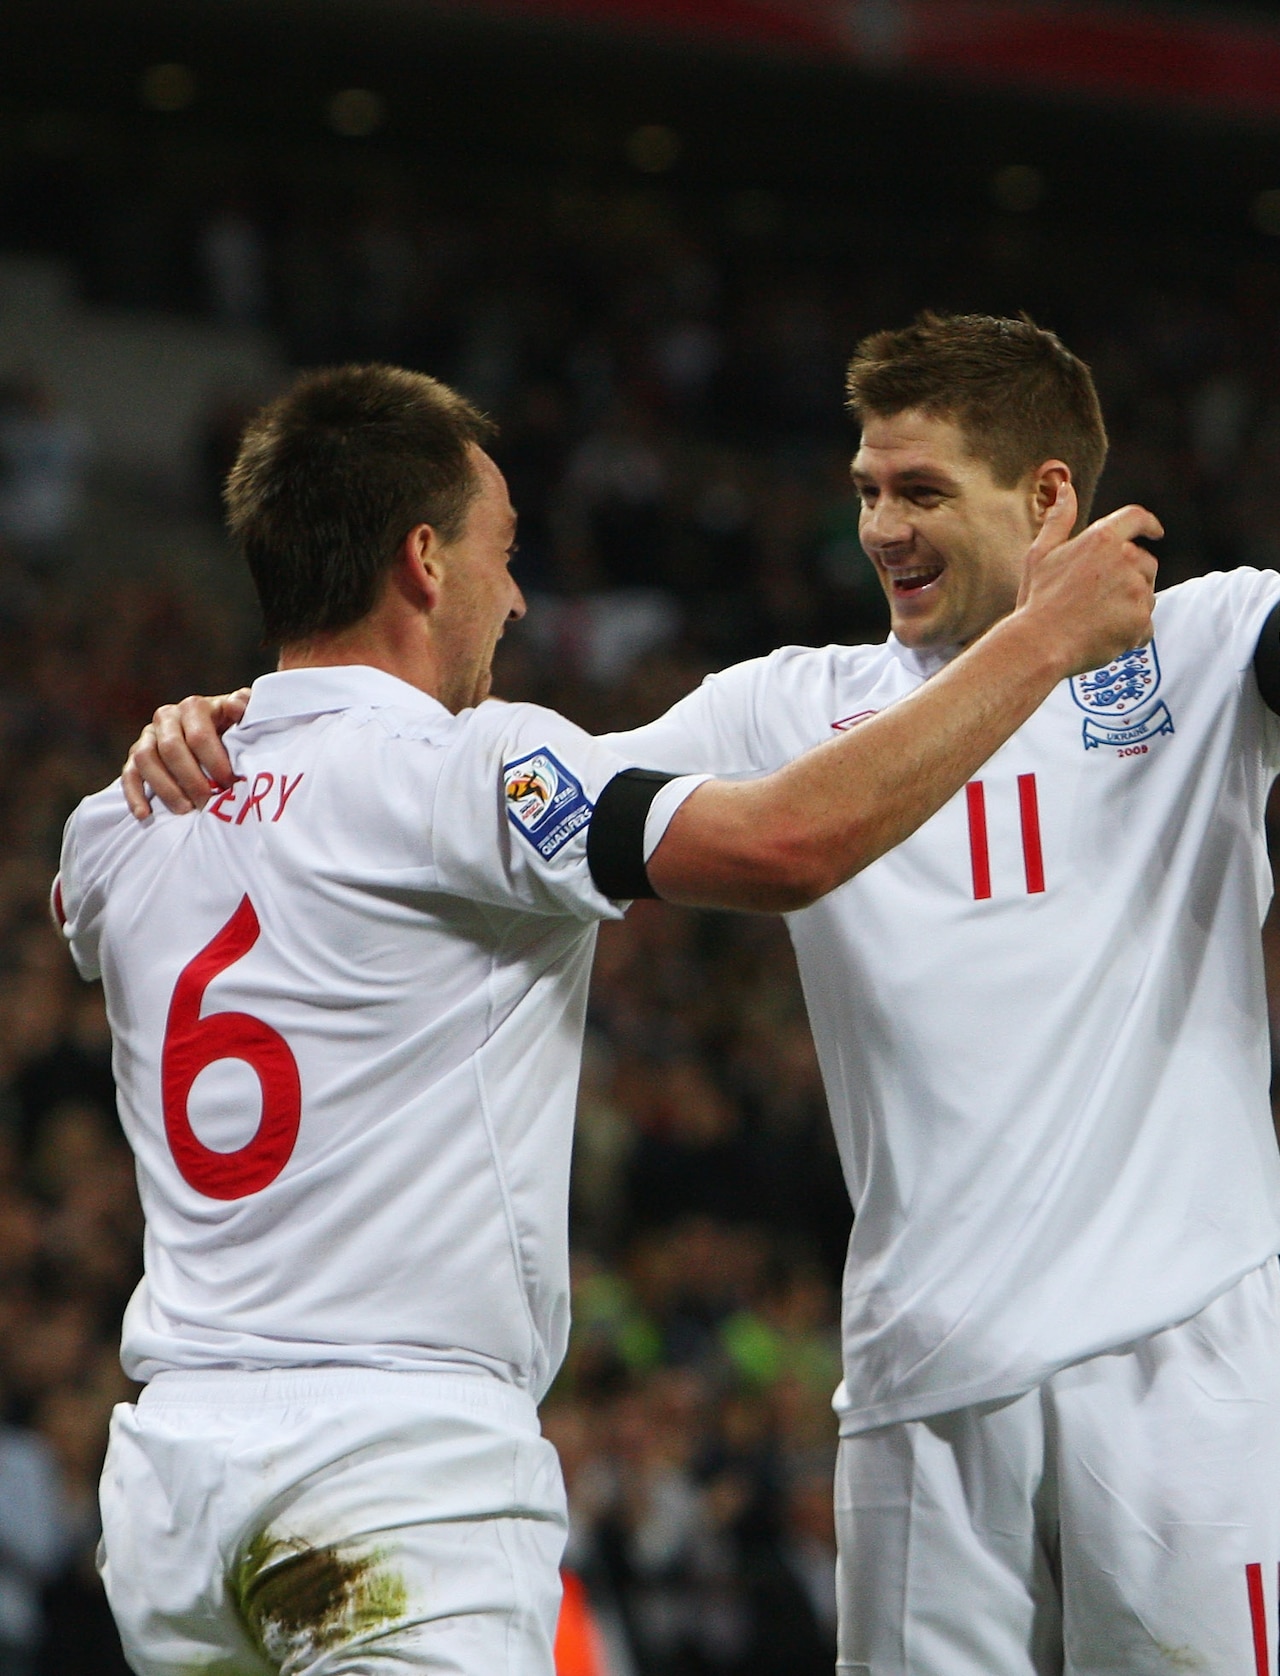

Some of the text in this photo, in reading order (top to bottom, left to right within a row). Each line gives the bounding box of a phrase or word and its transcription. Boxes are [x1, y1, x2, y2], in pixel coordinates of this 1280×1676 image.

[1106, 724, 1149, 741] UKRAINE
[1117, 744, 1148, 758] 2009
[206, 771, 304, 826] ERY
[966, 773, 1046, 901] 11
[162, 896, 302, 1201] 6
